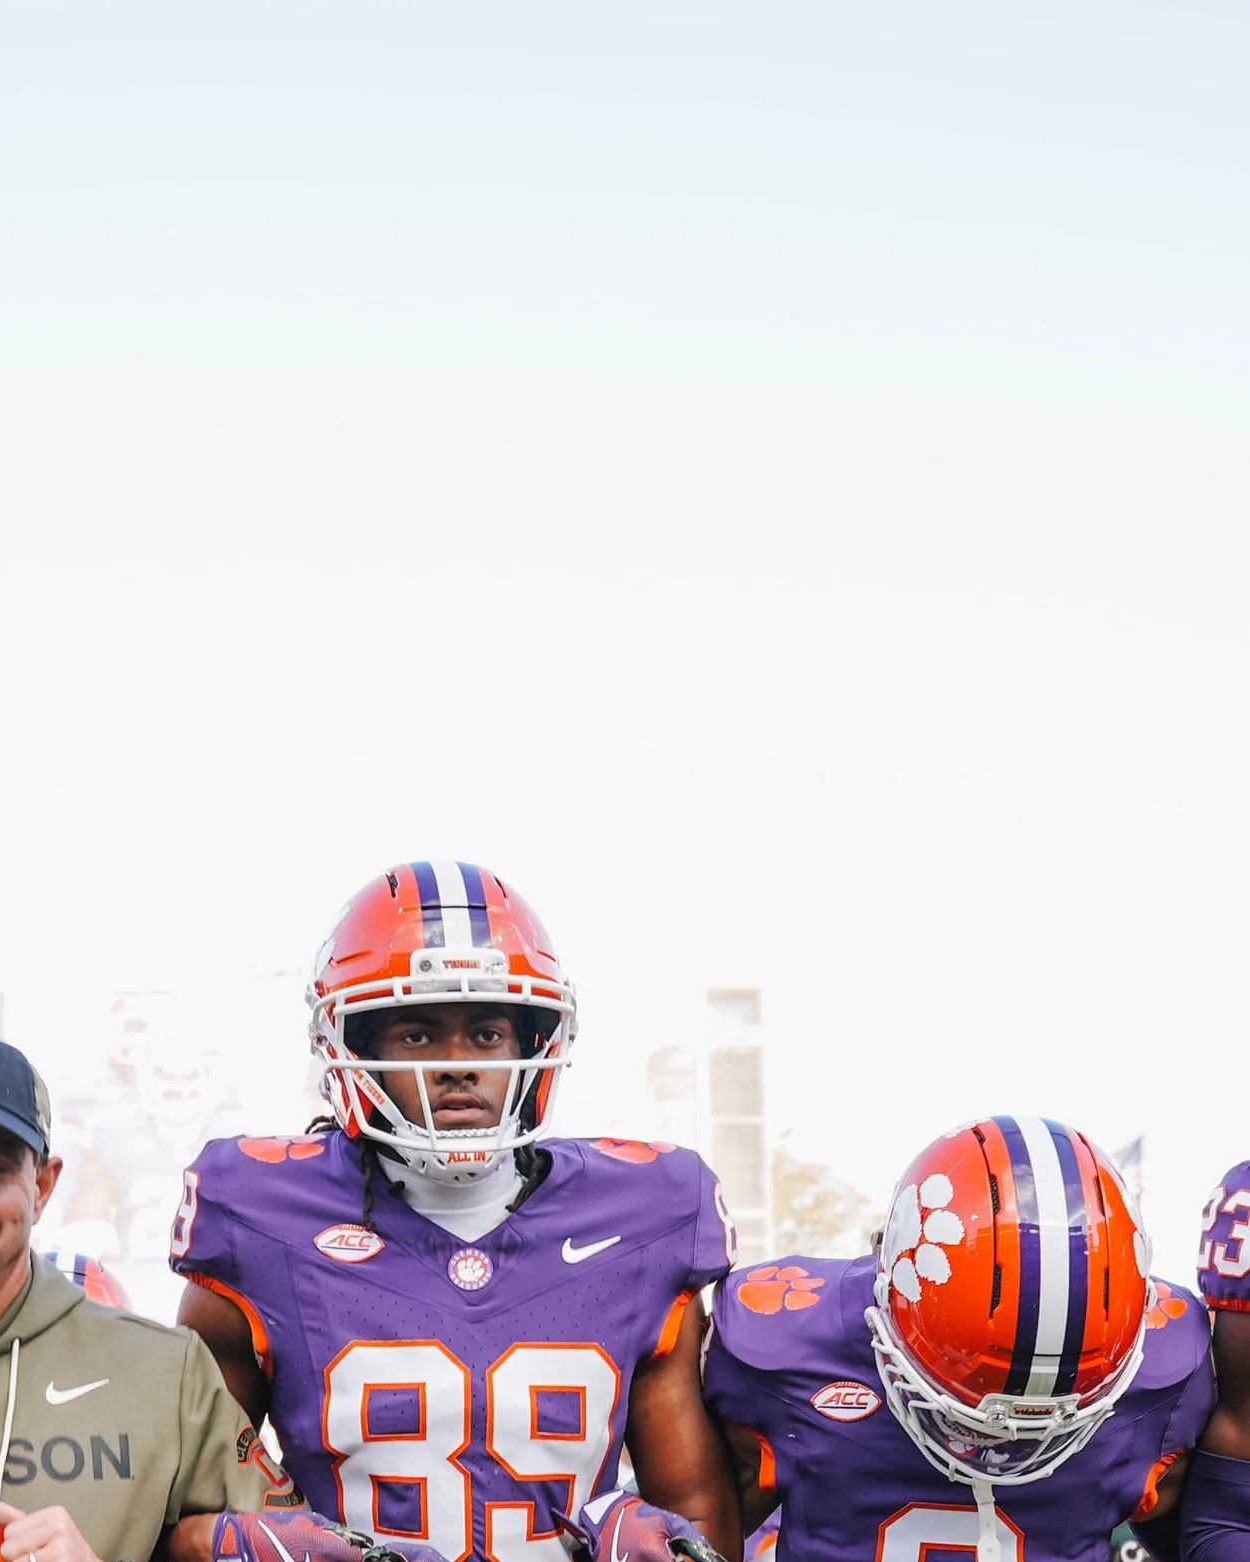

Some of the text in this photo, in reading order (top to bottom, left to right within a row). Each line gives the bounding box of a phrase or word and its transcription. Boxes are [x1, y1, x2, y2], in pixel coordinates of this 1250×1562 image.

[447, 1151, 486, 1163] ALL IN
[325, 1234, 374, 1247] ACC
[823, 1391, 871, 1405] ACC
